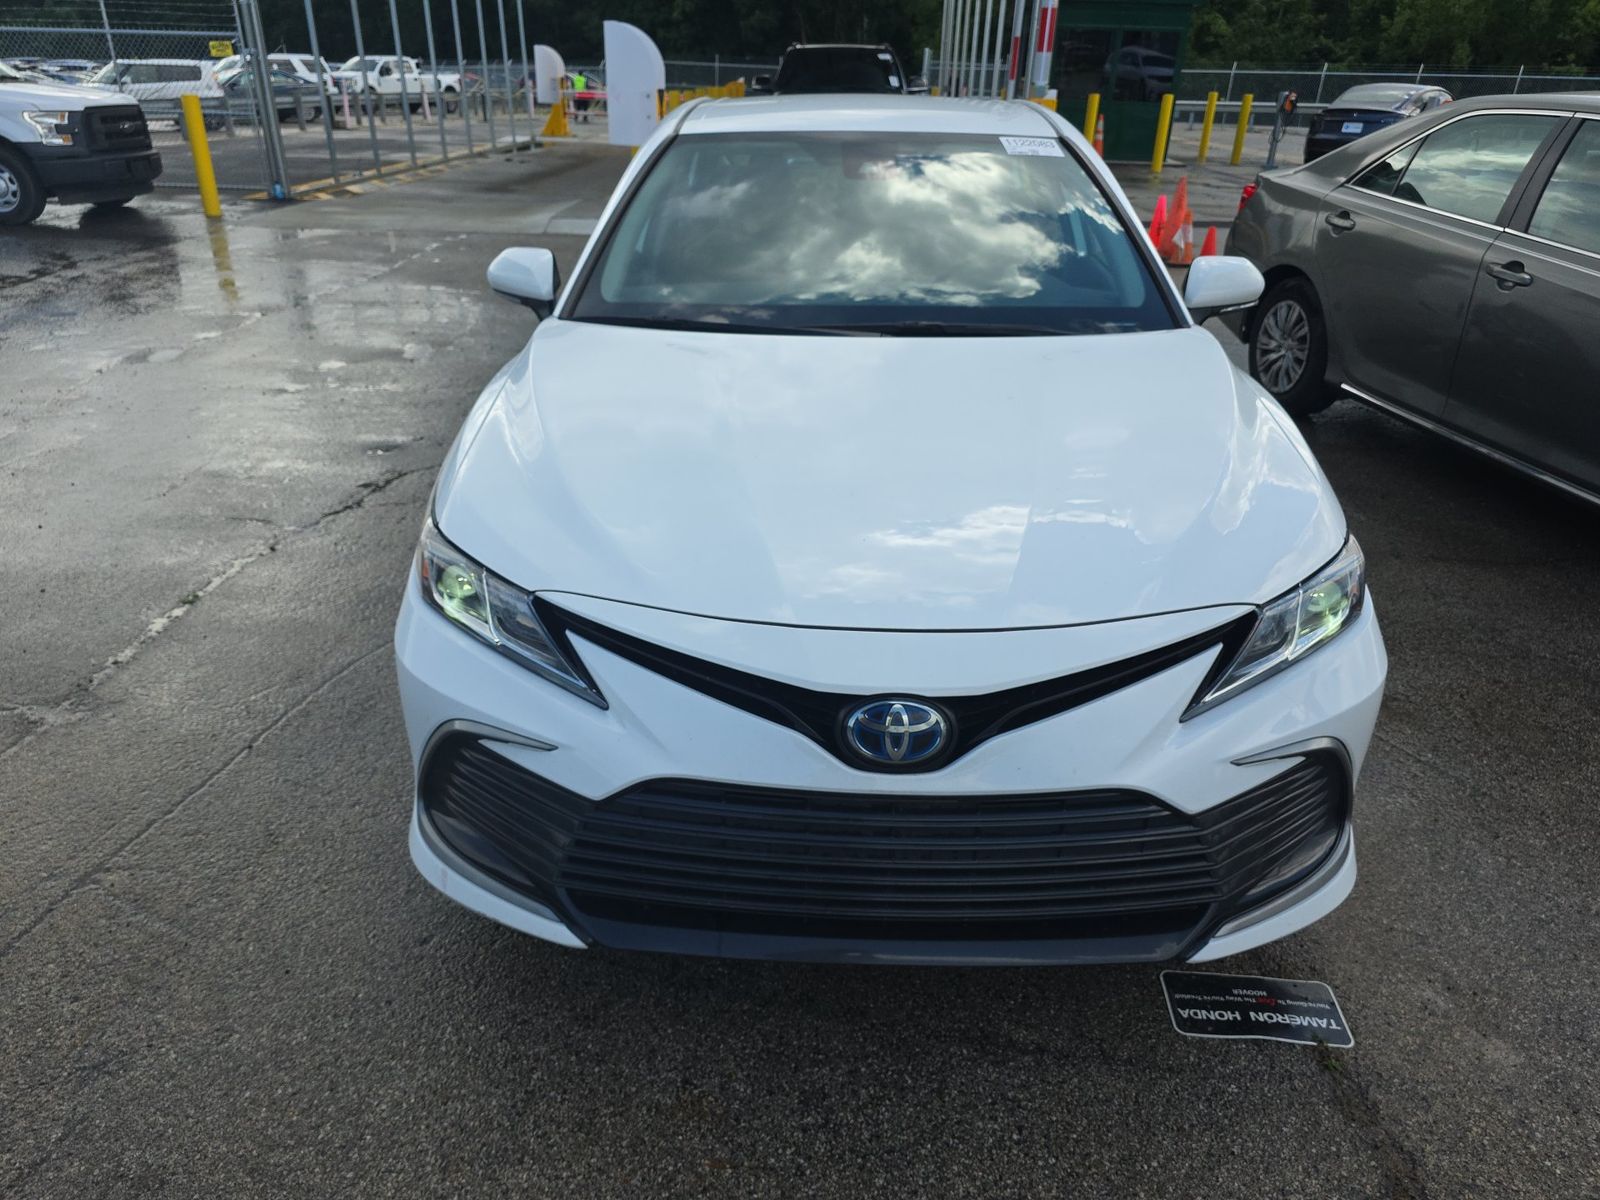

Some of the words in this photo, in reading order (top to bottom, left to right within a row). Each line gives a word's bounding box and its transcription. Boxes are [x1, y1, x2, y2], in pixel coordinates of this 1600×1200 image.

[1231, 988, 1268, 996] HOOVER
[1177, 1007, 1241, 1021] HONDA
[1249, 1011, 1341, 1030] TAMERON
